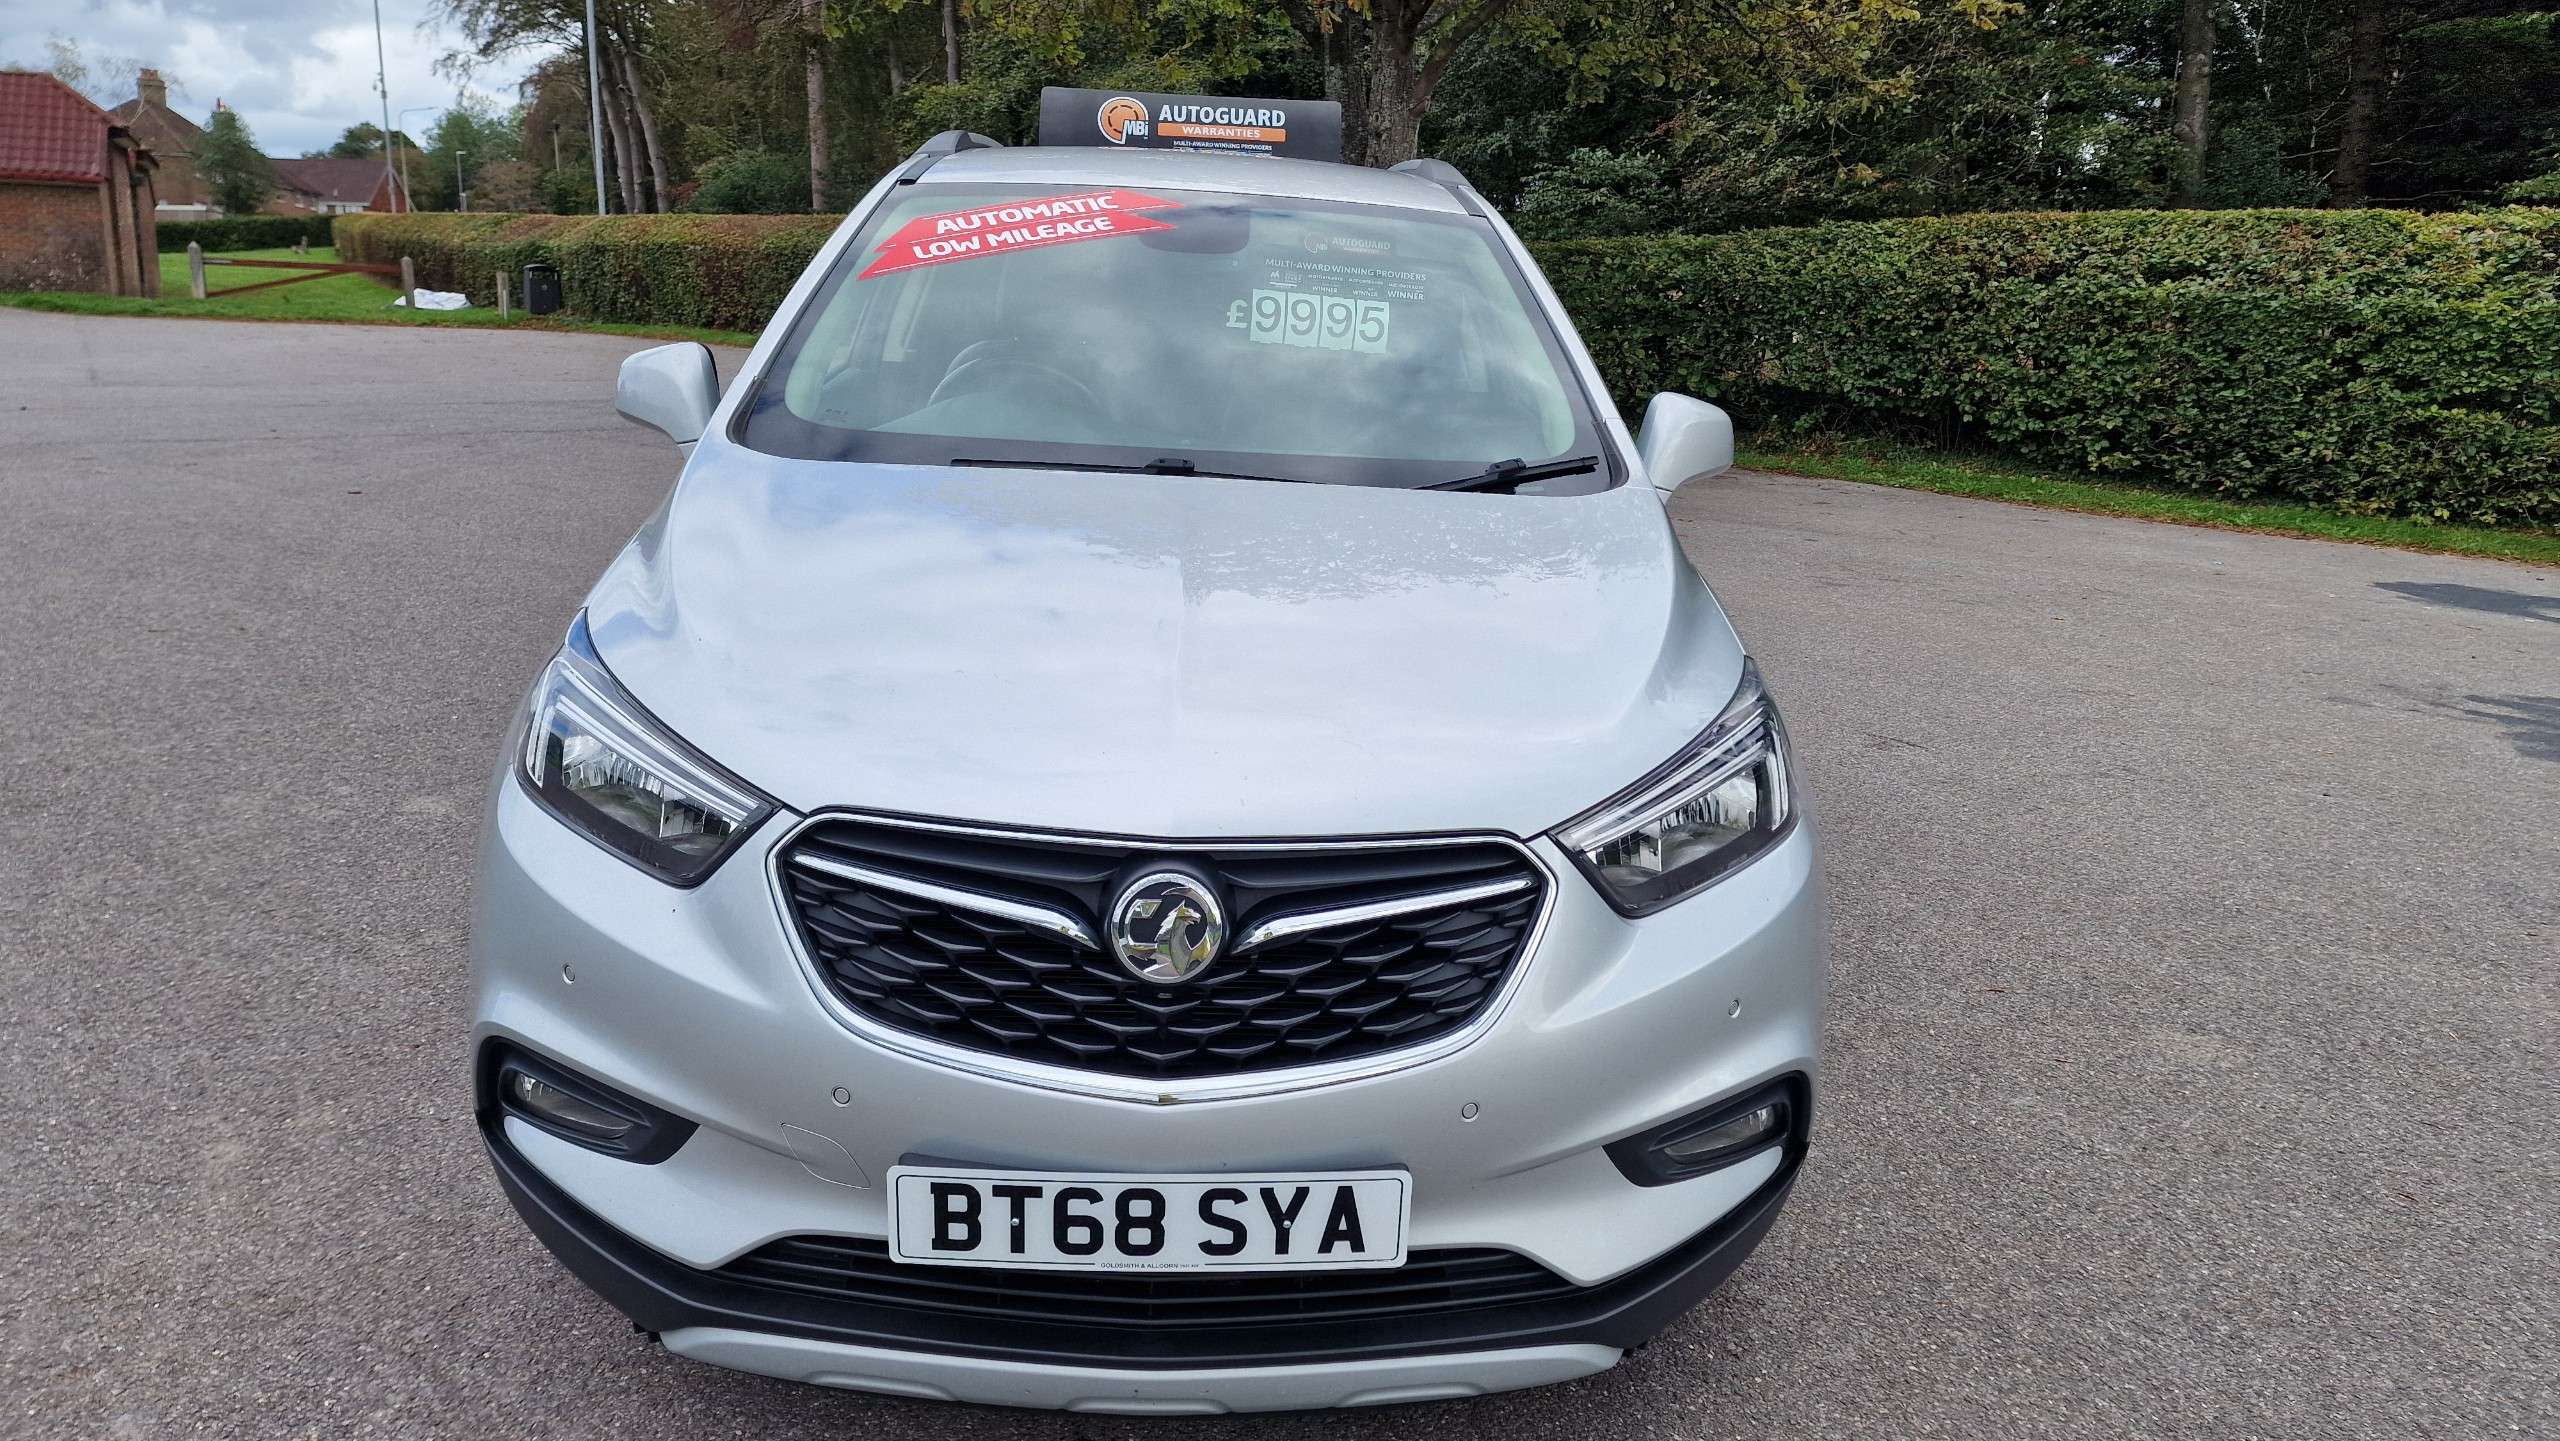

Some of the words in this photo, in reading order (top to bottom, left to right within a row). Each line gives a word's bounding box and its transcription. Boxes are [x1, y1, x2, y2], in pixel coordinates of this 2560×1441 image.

[1158, 104, 1286, 127] AUTOGUARD
[1181, 125, 1261, 139] WARRANTIES
[1173, 140, 1213, 149] MULTI-AWARD
[936, 195, 1121, 234] AUTOMATIC
[912, 231, 981, 260] LOW
[989, 216, 1115, 248] MILEAGE
[1332, 237, 1391, 250] AUTOGUARD
[1265, 258, 1331, 272] MULTI-AWARD
[1332, 264, 1375, 276] WINNING
[1376, 269, 1427, 281] PROVIDERS
[1312, 285, 1338, 293] WINNER
[1387, 290, 1425, 301] WINNER
[929, 1181, 1167, 1257] BT68
[1197, 1185, 1367, 1257] SYA
